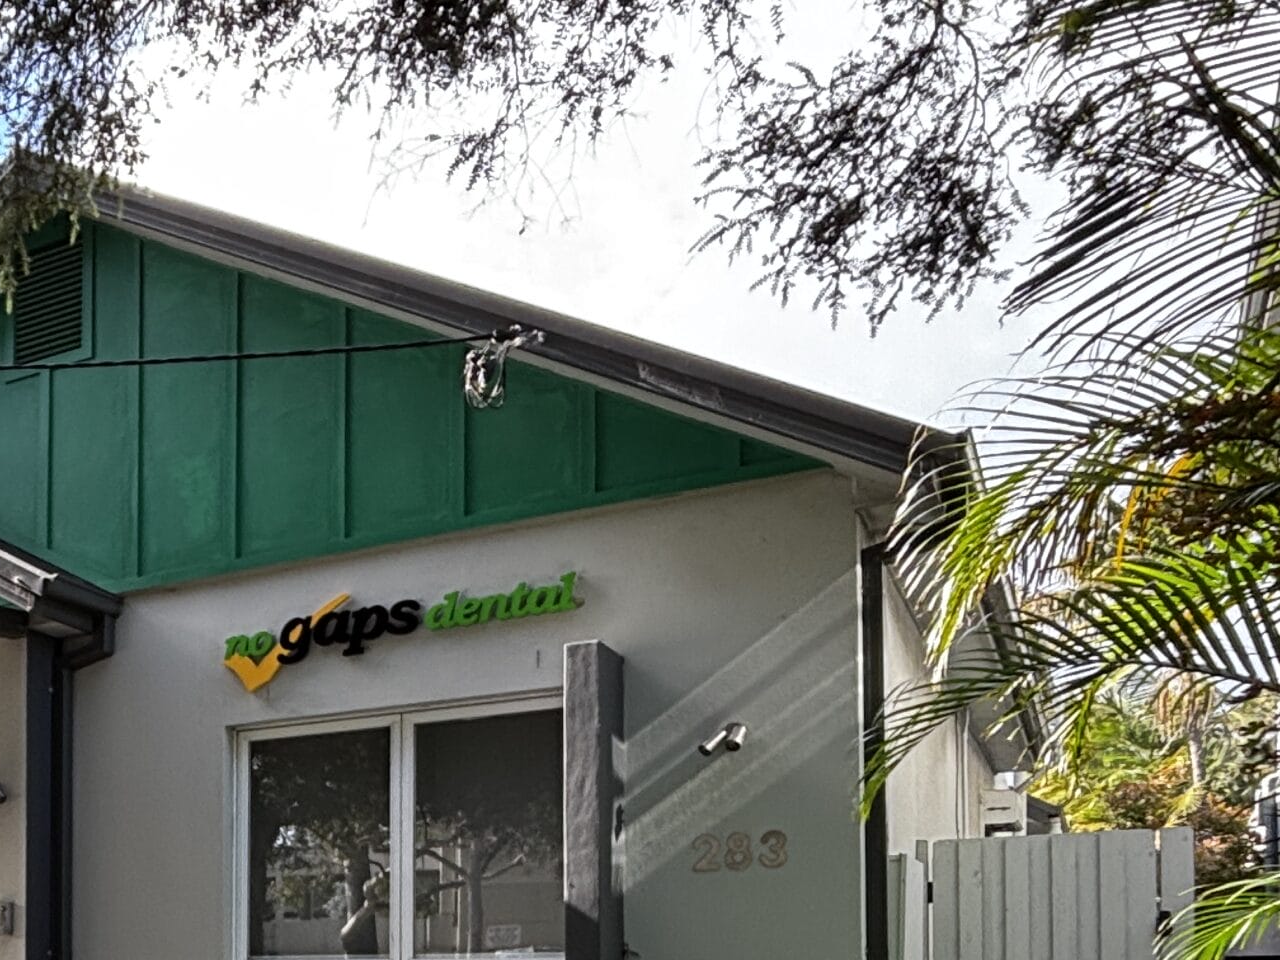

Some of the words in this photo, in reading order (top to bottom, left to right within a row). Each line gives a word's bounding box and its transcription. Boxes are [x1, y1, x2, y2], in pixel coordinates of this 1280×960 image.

[224, 631, 277, 661] no
[277, 599, 421, 665] gaps
[424, 571, 578, 633] dental
[691, 829, 789, 872] 283
